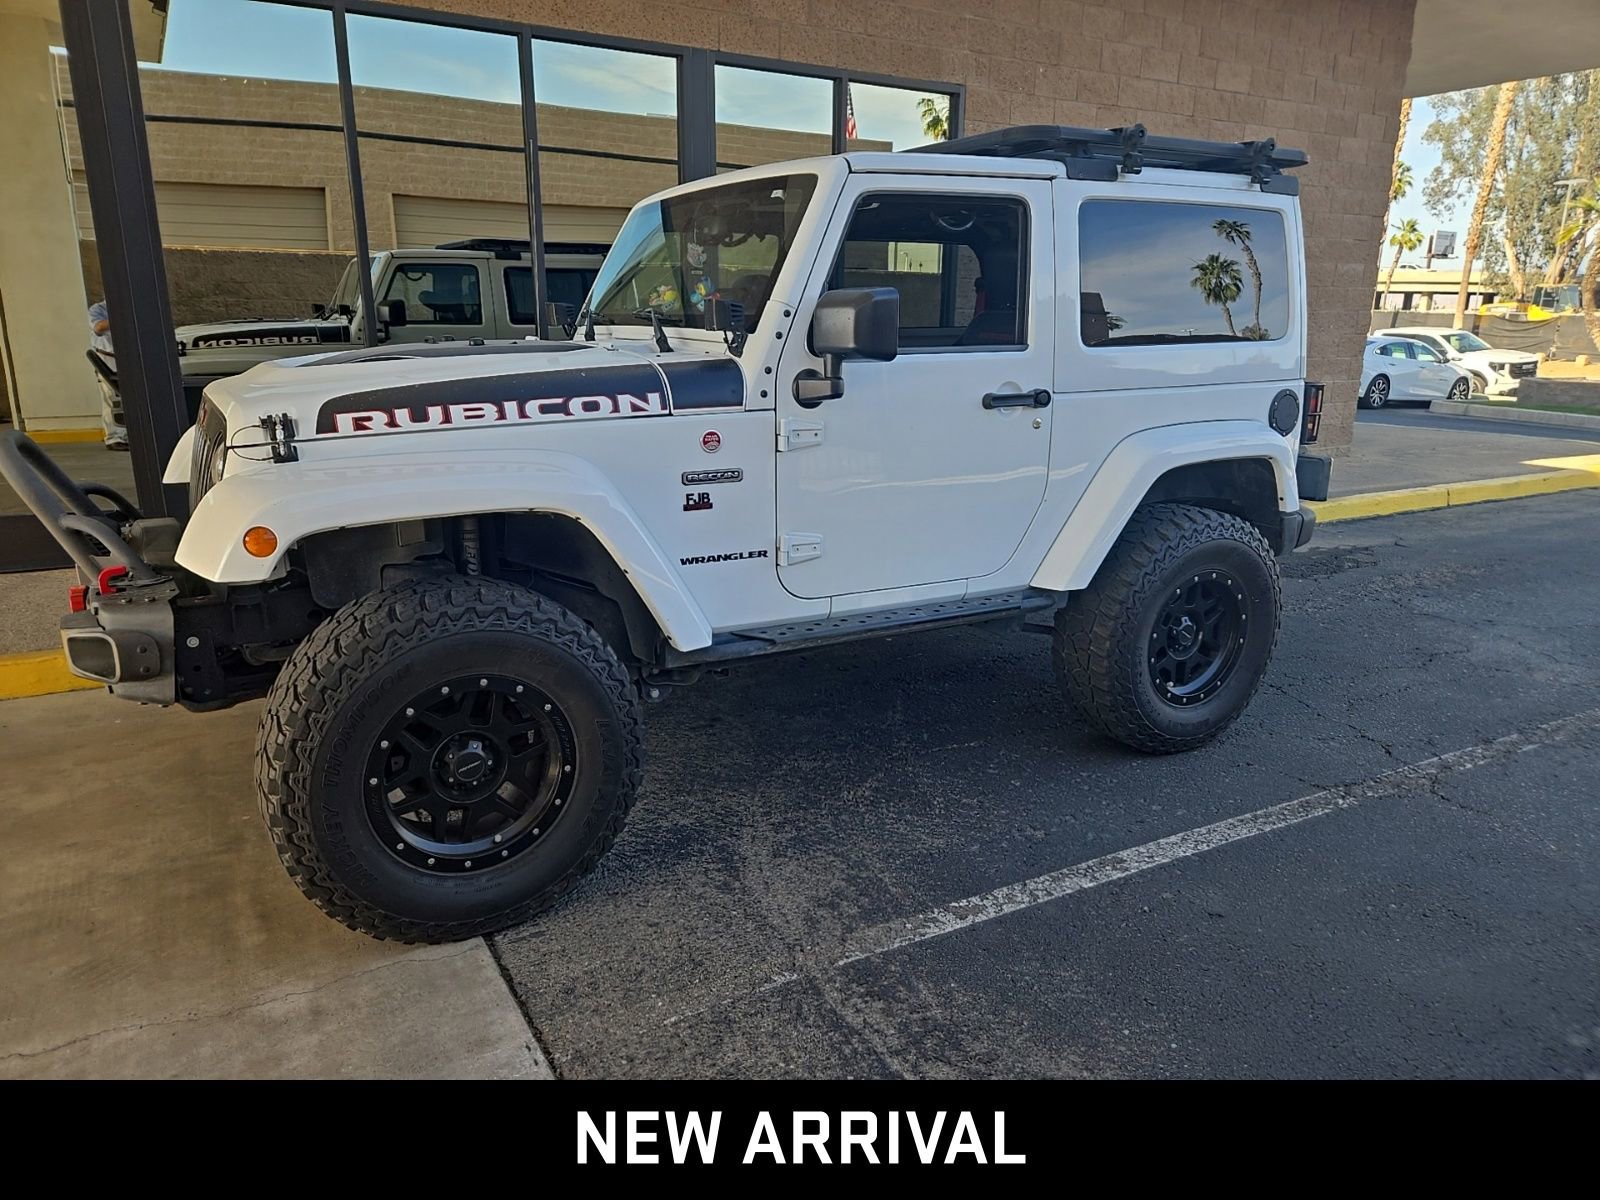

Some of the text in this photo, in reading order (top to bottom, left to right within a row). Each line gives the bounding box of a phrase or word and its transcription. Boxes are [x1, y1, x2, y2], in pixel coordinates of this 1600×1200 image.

[335, 392, 665, 433] RUBICON
[687, 471, 739, 481] RECON
[685, 492, 711, 505] FJB
[679, 549, 768, 566] WRANGLER
